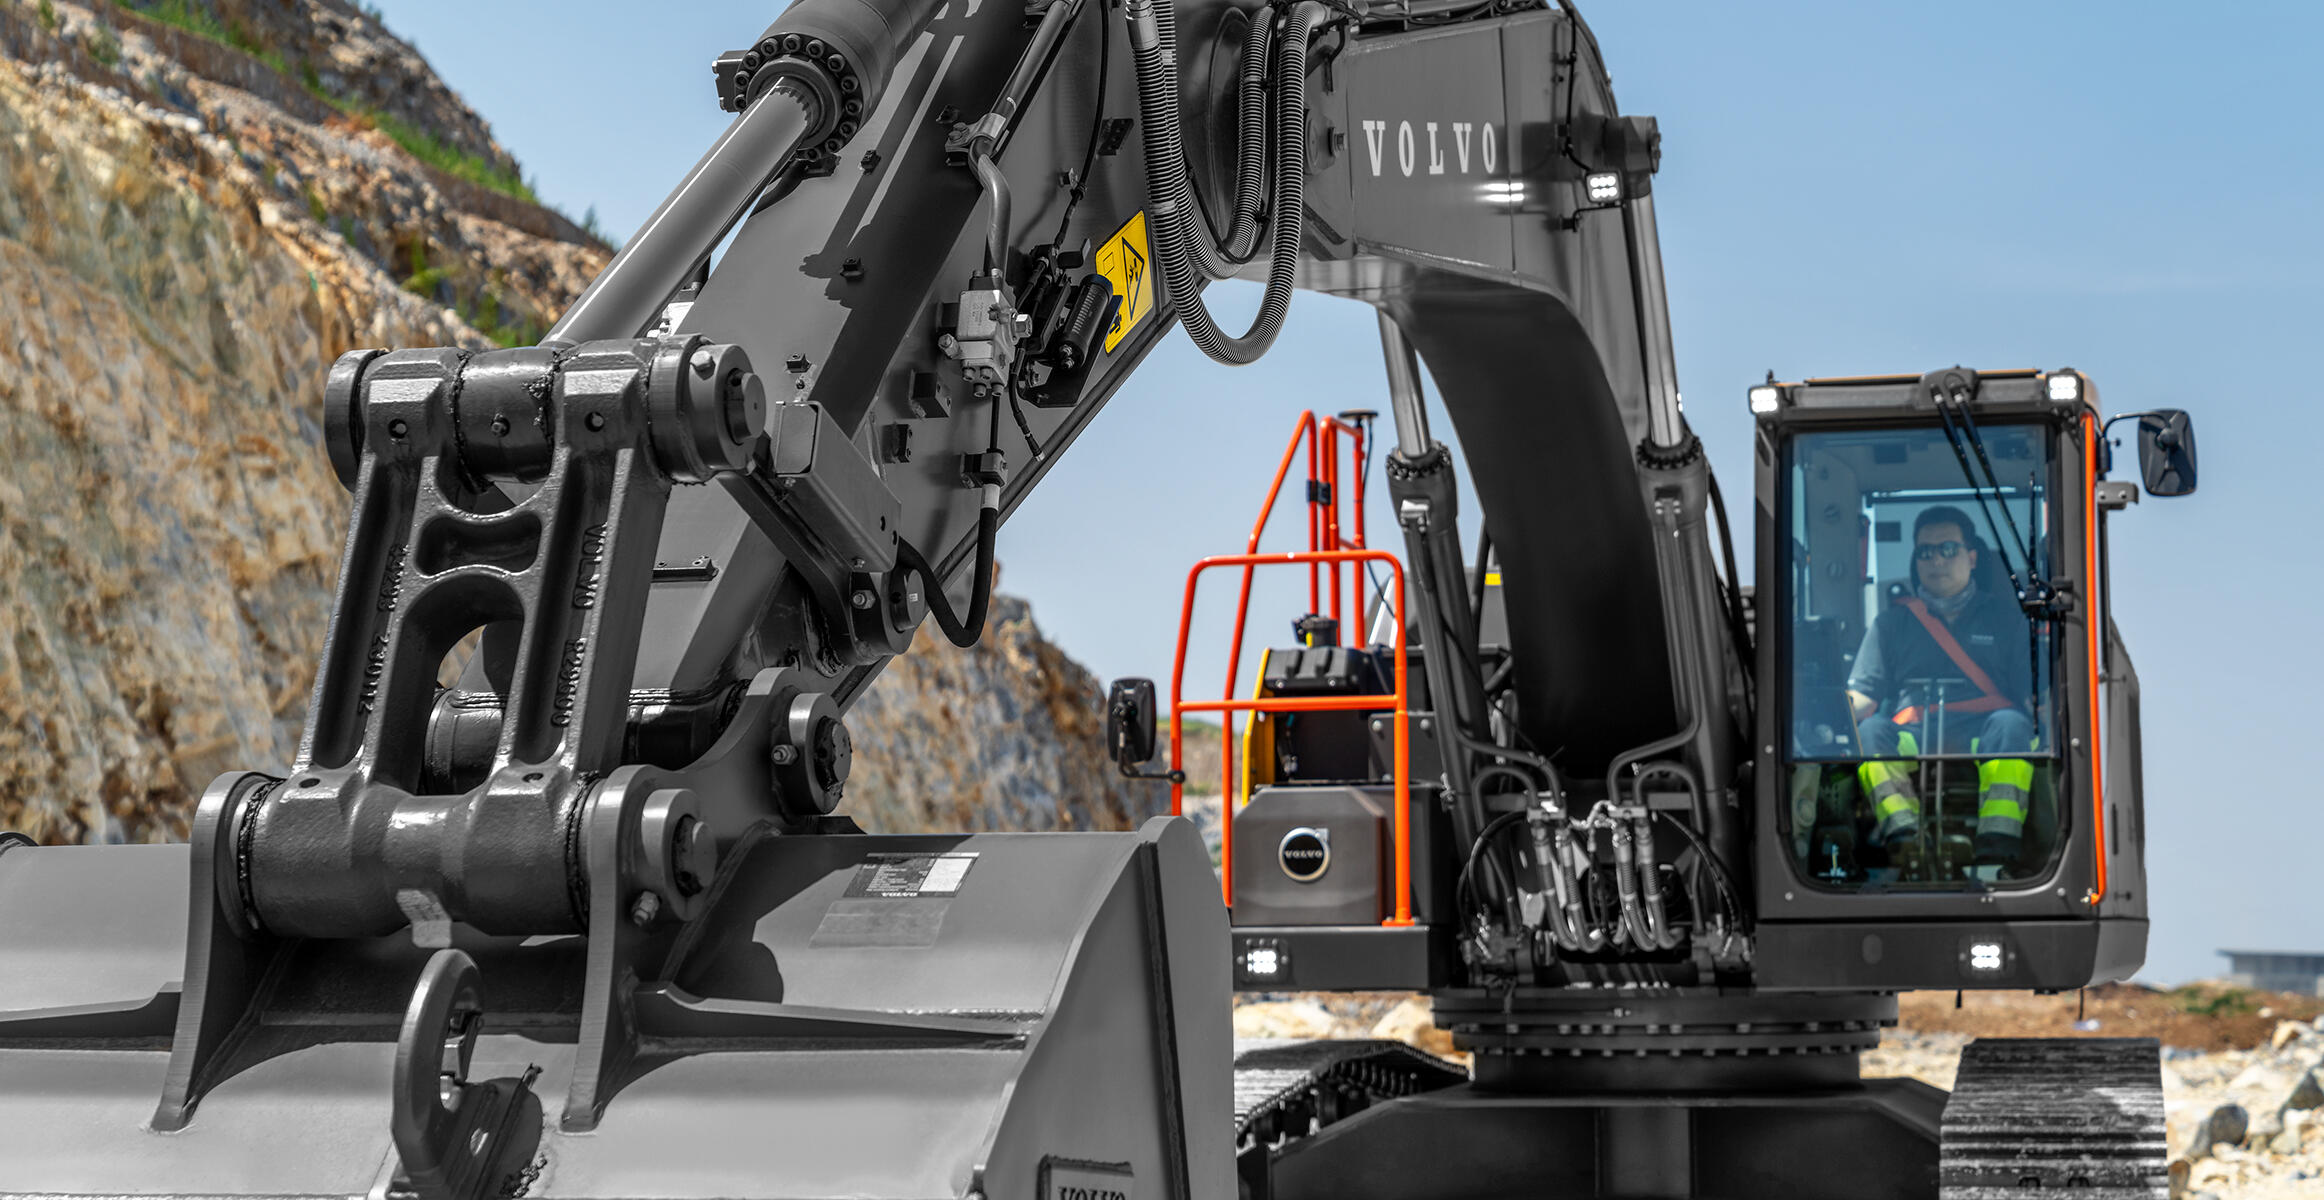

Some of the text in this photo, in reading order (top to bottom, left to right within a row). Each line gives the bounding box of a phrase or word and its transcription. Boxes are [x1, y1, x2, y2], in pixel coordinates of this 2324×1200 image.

[1362, 120, 1497, 177] VOLVO
[571, 521, 608, 609] VOLVO
[1284, 849, 1323, 859] VOLVO
